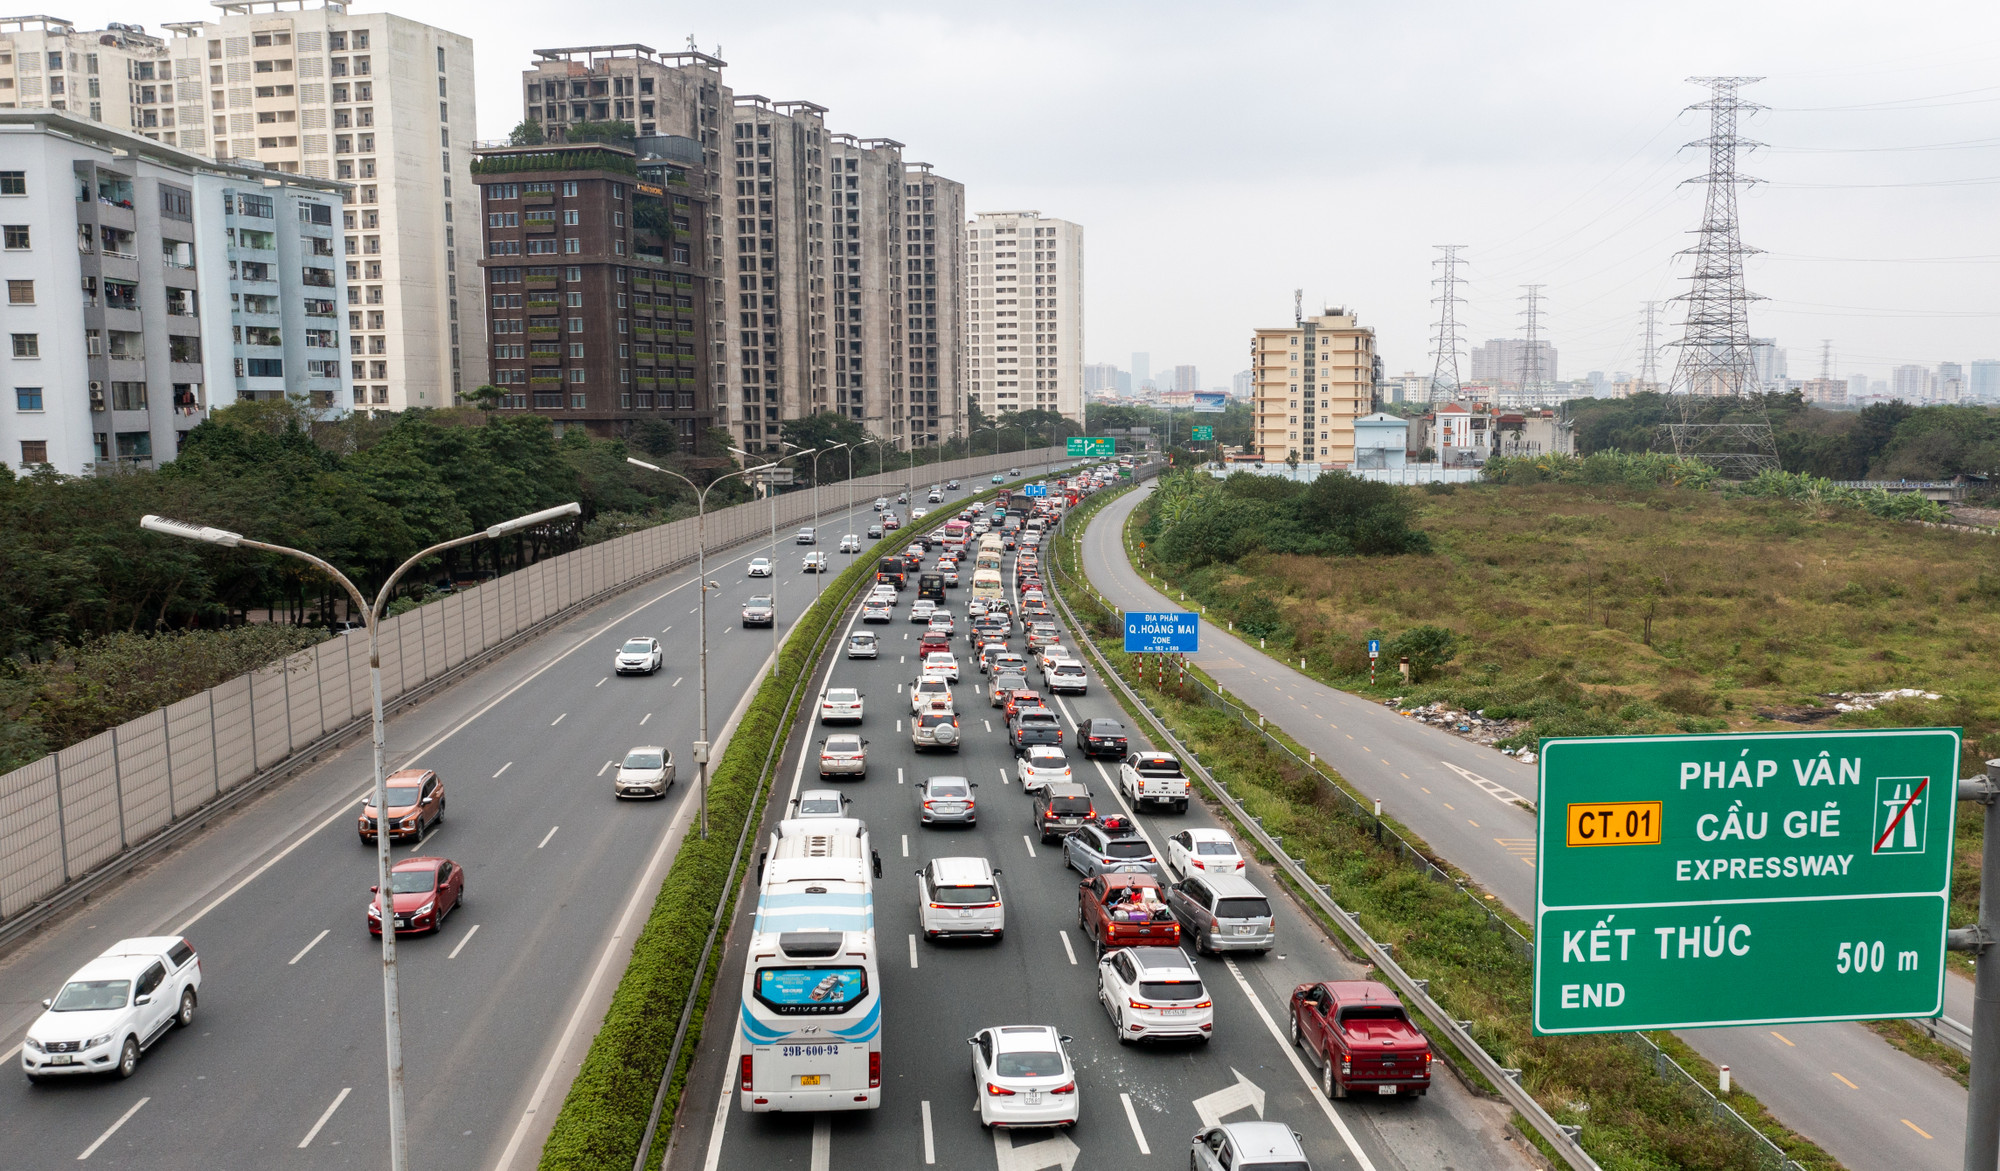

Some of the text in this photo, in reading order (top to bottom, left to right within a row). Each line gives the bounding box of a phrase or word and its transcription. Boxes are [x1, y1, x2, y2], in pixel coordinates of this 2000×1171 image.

[1145, 613, 1178, 624] ĐỊA PHẬN
[1178, 625, 1195, 634] MAI
[1152, 636, 1171, 644] ZONE
[1679, 748, 1862, 790] PHÁP VÂN
[1578, 810, 1651, 839] CT.01
[1696, 799, 1841, 842] CẦU GIẼ
[1676, 854, 1855, 881] EXPRESSWAY
[1562, 914, 1752, 963] KẾT THÚC
[1836, 940, 1919, 974] 500 m
[1561, 982, 1626, 1009] END
[782, 1045, 839, 1056] 29B-600-92
